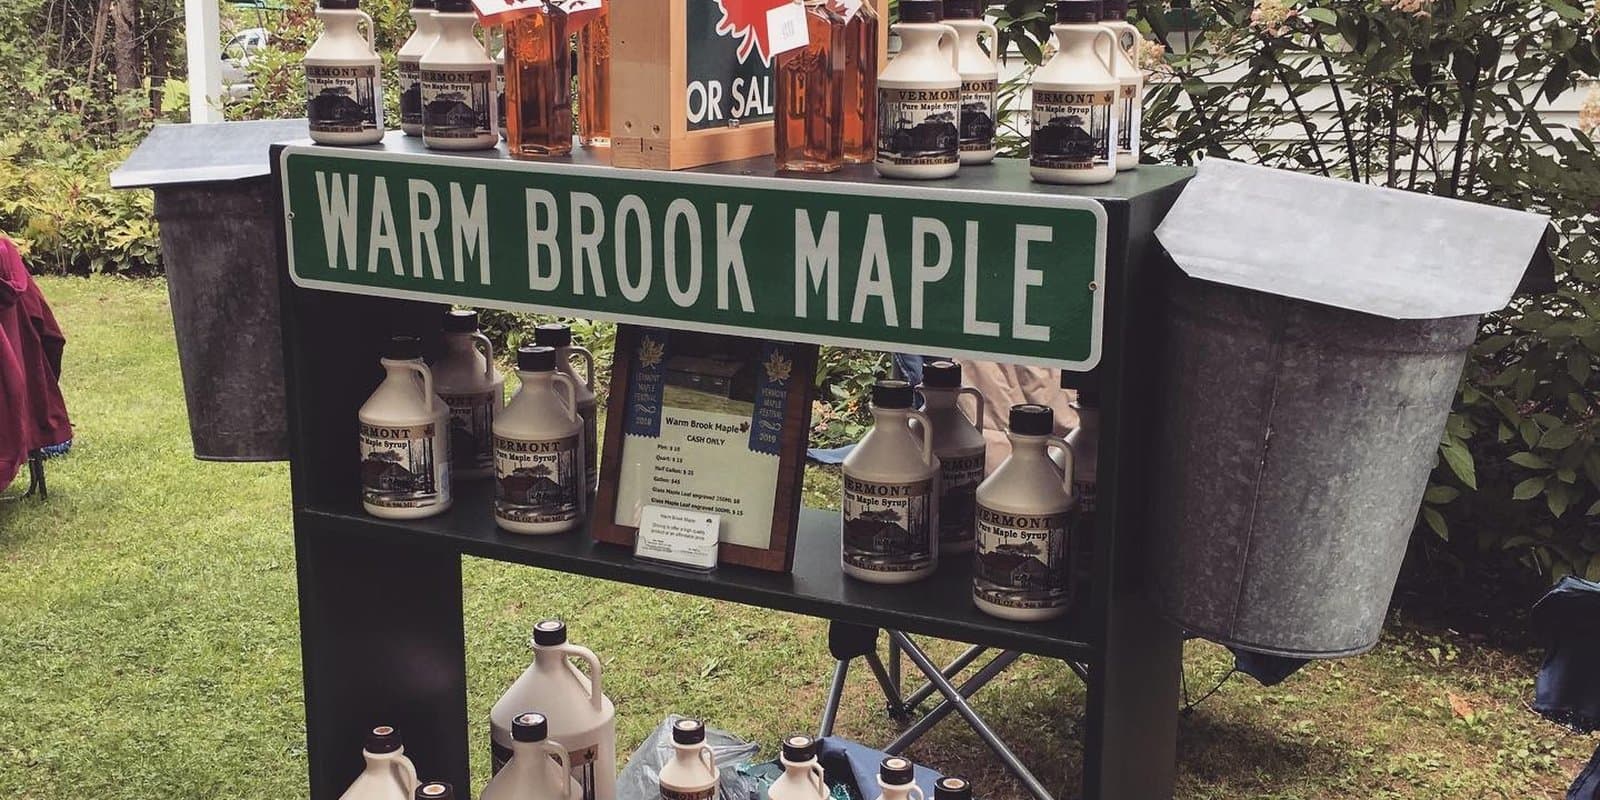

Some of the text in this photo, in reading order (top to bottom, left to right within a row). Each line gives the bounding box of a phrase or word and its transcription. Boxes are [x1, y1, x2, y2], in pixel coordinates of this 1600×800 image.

[961, 82, 993, 92] MONT
[687, 76, 774, 124] OR SAL
[902, 102, 918, 110] Pure
[920, 102, 940, 112] Maple
[1046, 106, 1065, 114] Maple
[1067, 107, 1089, 115] Syrup
[315, 171, 1053, 342] WARM BROOK MAPLE
[666, 417, 739, 433] Warm Brook Maple
[366, 438, 382, 446] Maple
[384, 440, 407, 448] Syrup
[687, 435, 704, 443] CASH
[509, 453, 531, 461] Maple
[533, 454, 557, 462] Syrup
[692, 493, 715, 501] engraved
[856, 495, 880, 506] Maple
[881, 498, 908, 508] Syrup
[691, 504, 714, 512] engraved
[993, 527, 1018, 539] Maple
[1020, 531, 1047, 541] Syrup
